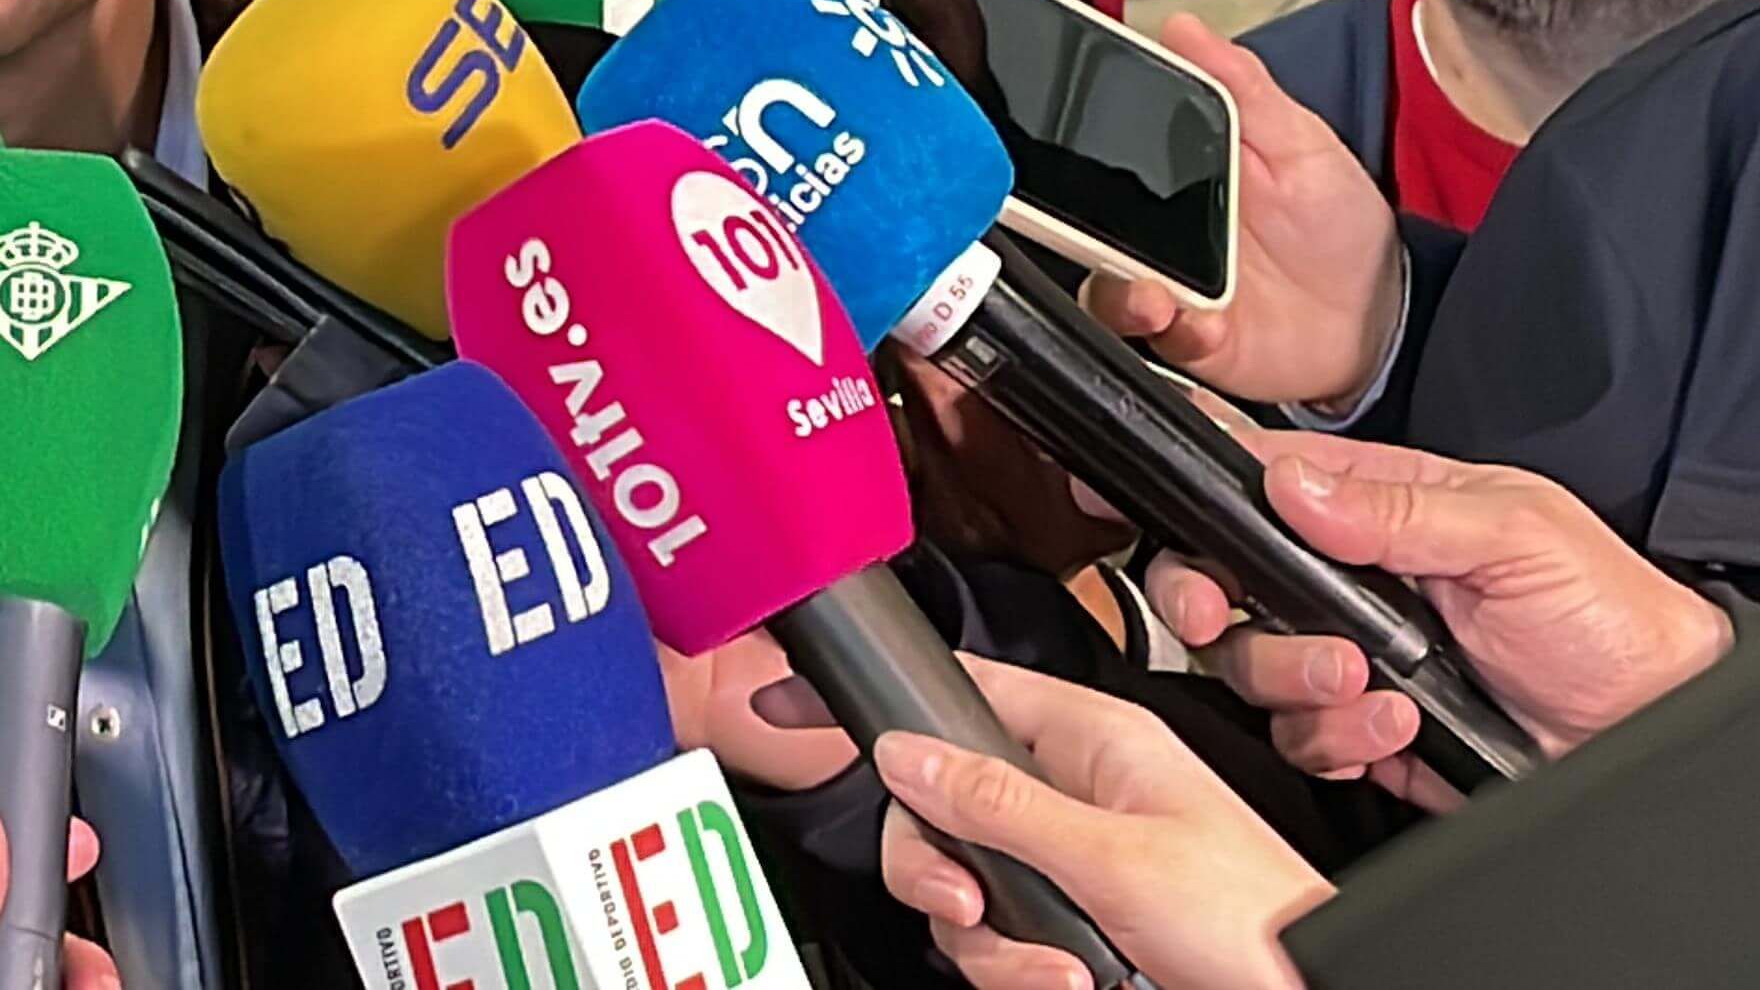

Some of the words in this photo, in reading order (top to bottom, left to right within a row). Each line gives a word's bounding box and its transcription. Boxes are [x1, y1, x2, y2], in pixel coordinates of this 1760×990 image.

[691, 209, 799, 291] 101
[769, 131, 866, 233] icias
[504, 237, 708, 568] 101tv.es
[786, 376, 876, 438] Sevilla
[253, 555, 388, 739] ED
[452, 471, 613, 657] ED
[610, 800, 769, 990] ED
